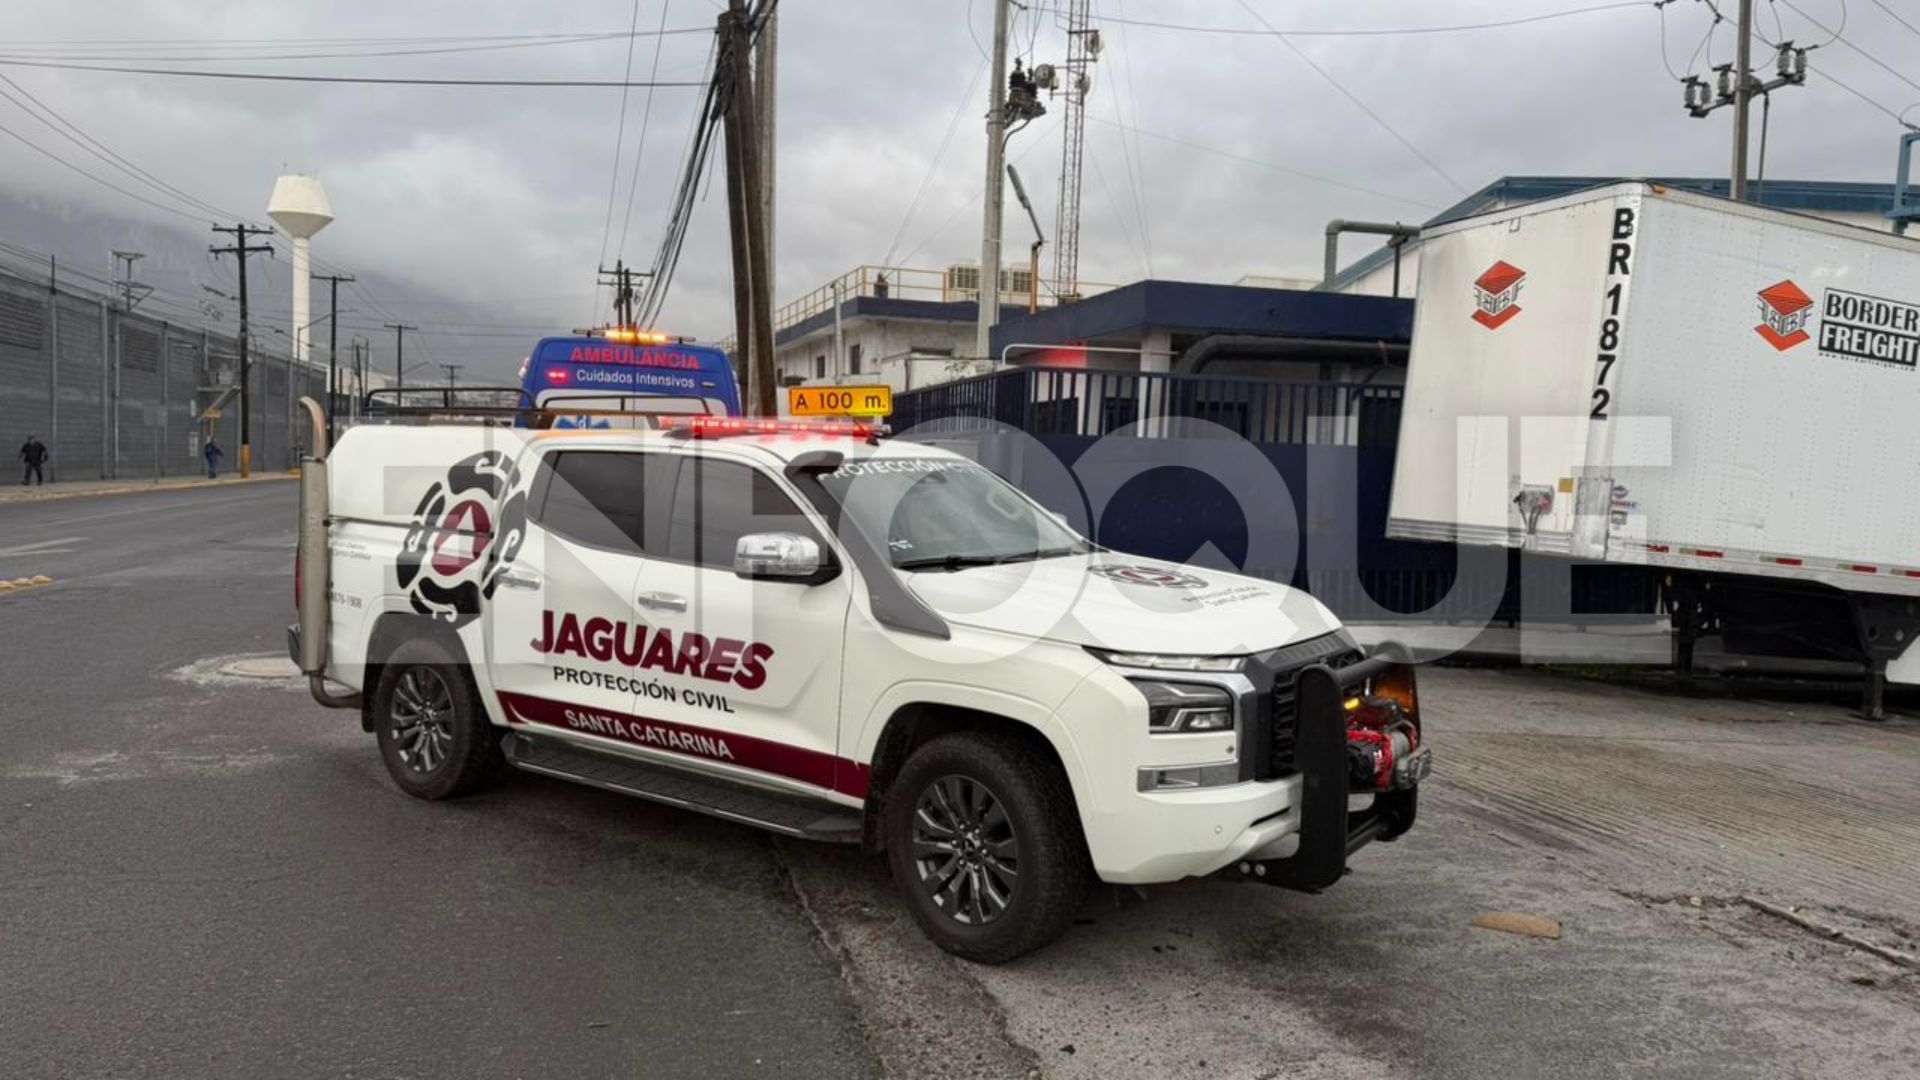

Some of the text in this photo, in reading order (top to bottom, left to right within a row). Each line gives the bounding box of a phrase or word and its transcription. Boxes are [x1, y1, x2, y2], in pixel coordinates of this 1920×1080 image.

[1825, 293, 1918, 332] BORDER
[570, 346, 699, 369] AMBULANCIA
[1821, 322, 1918, 363] FREIGHT
[576, 369, 696, 388] Cuidados Intensivos
[795, 391, 887, 409] A 100 m.
[530, 609, 775, 690] JAGUARES
[553, 665, 735, 713] PROTECCIÓN CIVIL
[564, 709, 735, 760] SANTA CATARINA
